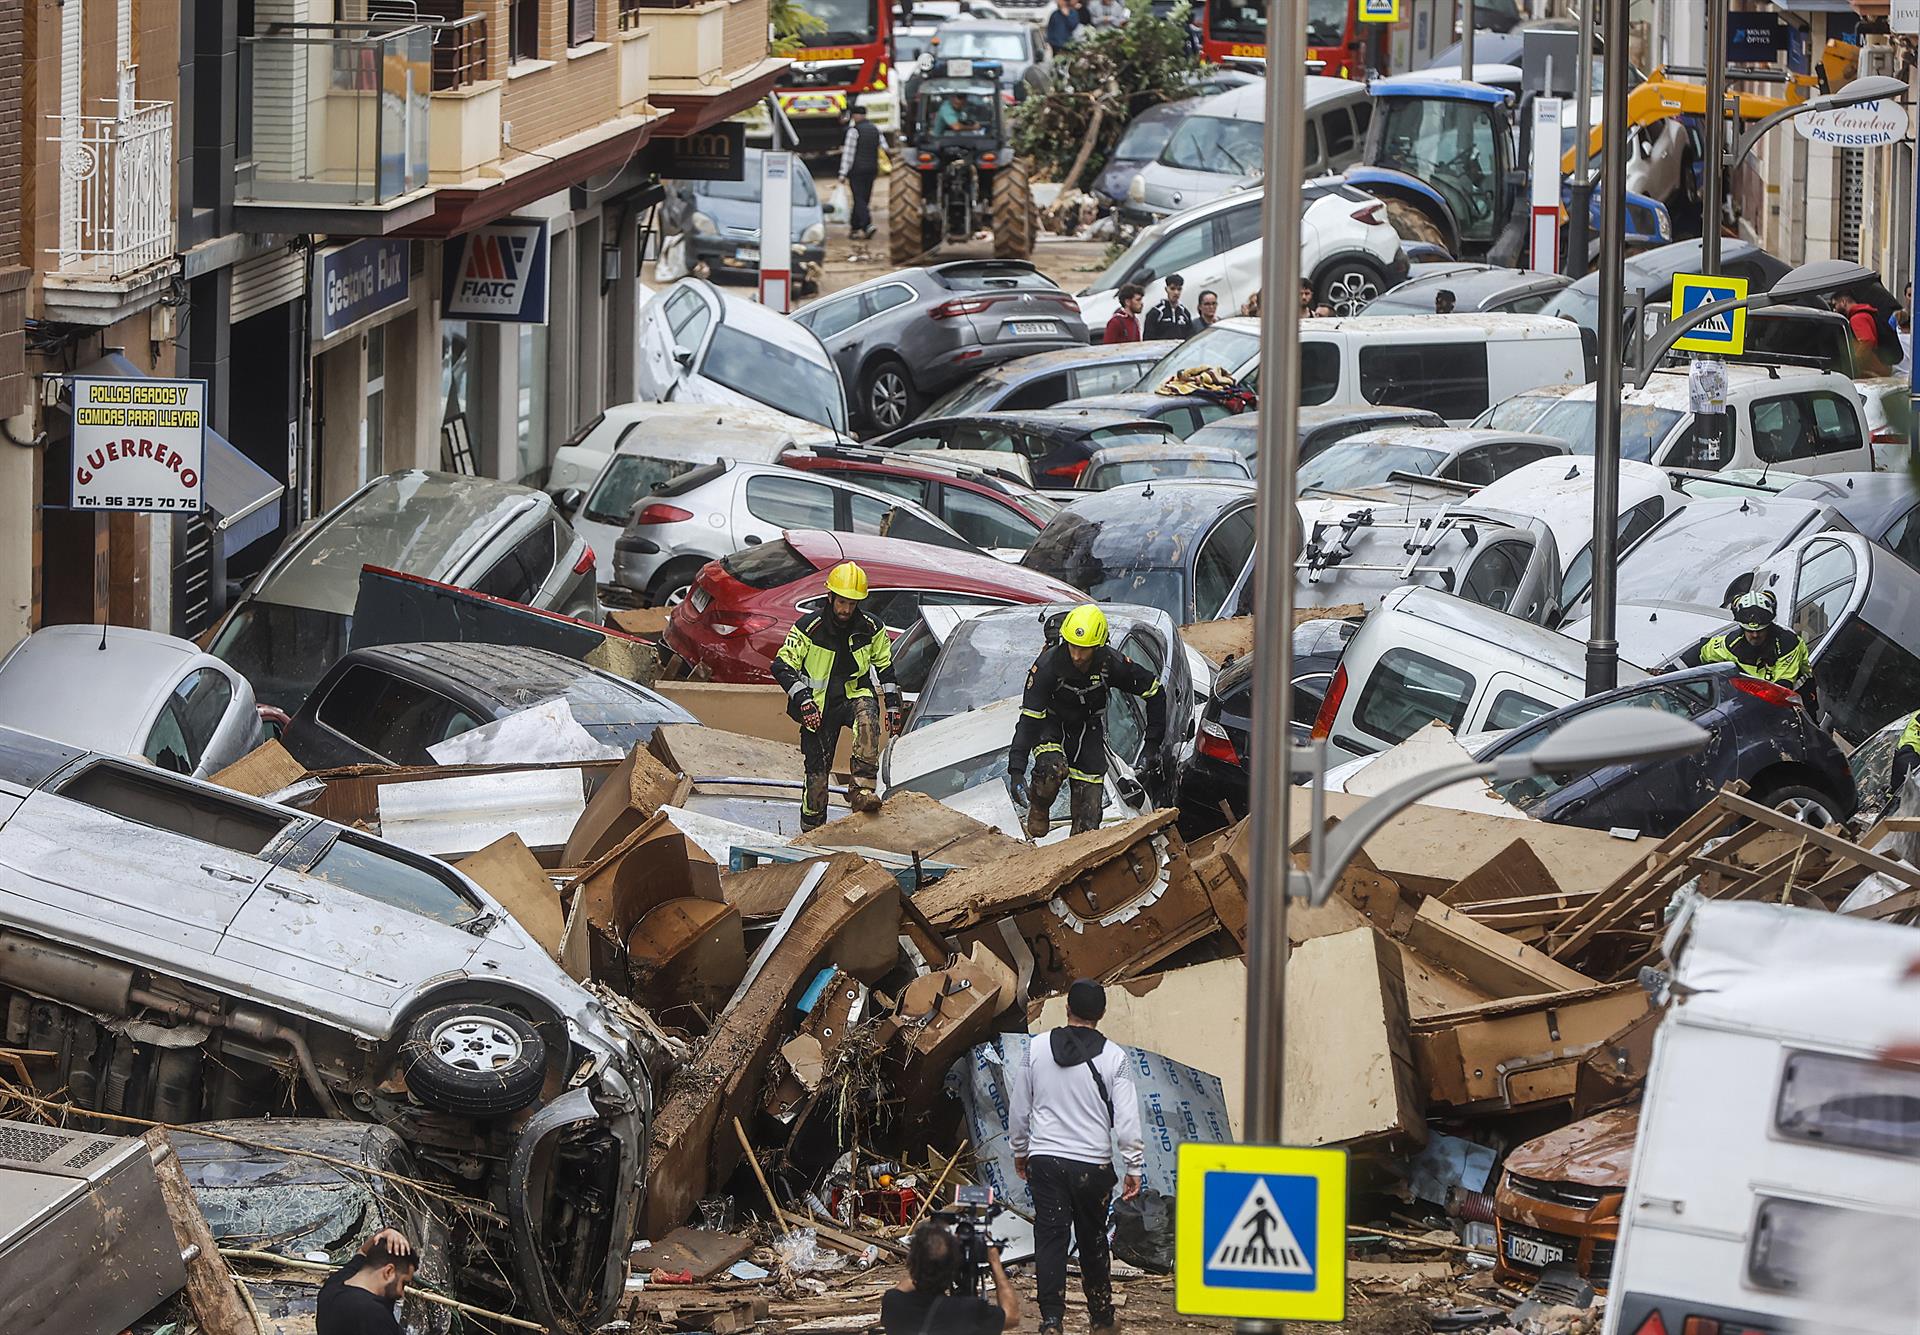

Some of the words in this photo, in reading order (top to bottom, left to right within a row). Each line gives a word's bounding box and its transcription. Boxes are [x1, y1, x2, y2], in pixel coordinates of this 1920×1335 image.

[1812, 127, 1891, 145] PASTISSERIA
[326, 255, 374, 317] Gestoría
[461, 281, 516, 298] FIATC
[459, 296, 512, 305] SEGUROS
[90, 385, 131, 403] POLLOS
[132, 387, 177, 405] ASADOS
[178, 387, 189, 405] Y
[77, 408, 125, 426] COMIDAS
[127, 409, 156, 427] PARA
[158, 410, 199, 428] LLEVAR
[77, 439, 198, 488] GUERRERO
[78, 496, 100, 506] Tel.
[105, 496, 123, 506] 96
[127, 497, 153, 507] 375
[158, 497, 175, 508] 70
[179, 498, 197, 508] 76
[1135, 1047, 1151, 1077] ND
[1514, 1240, 1538, 1261] 0827
